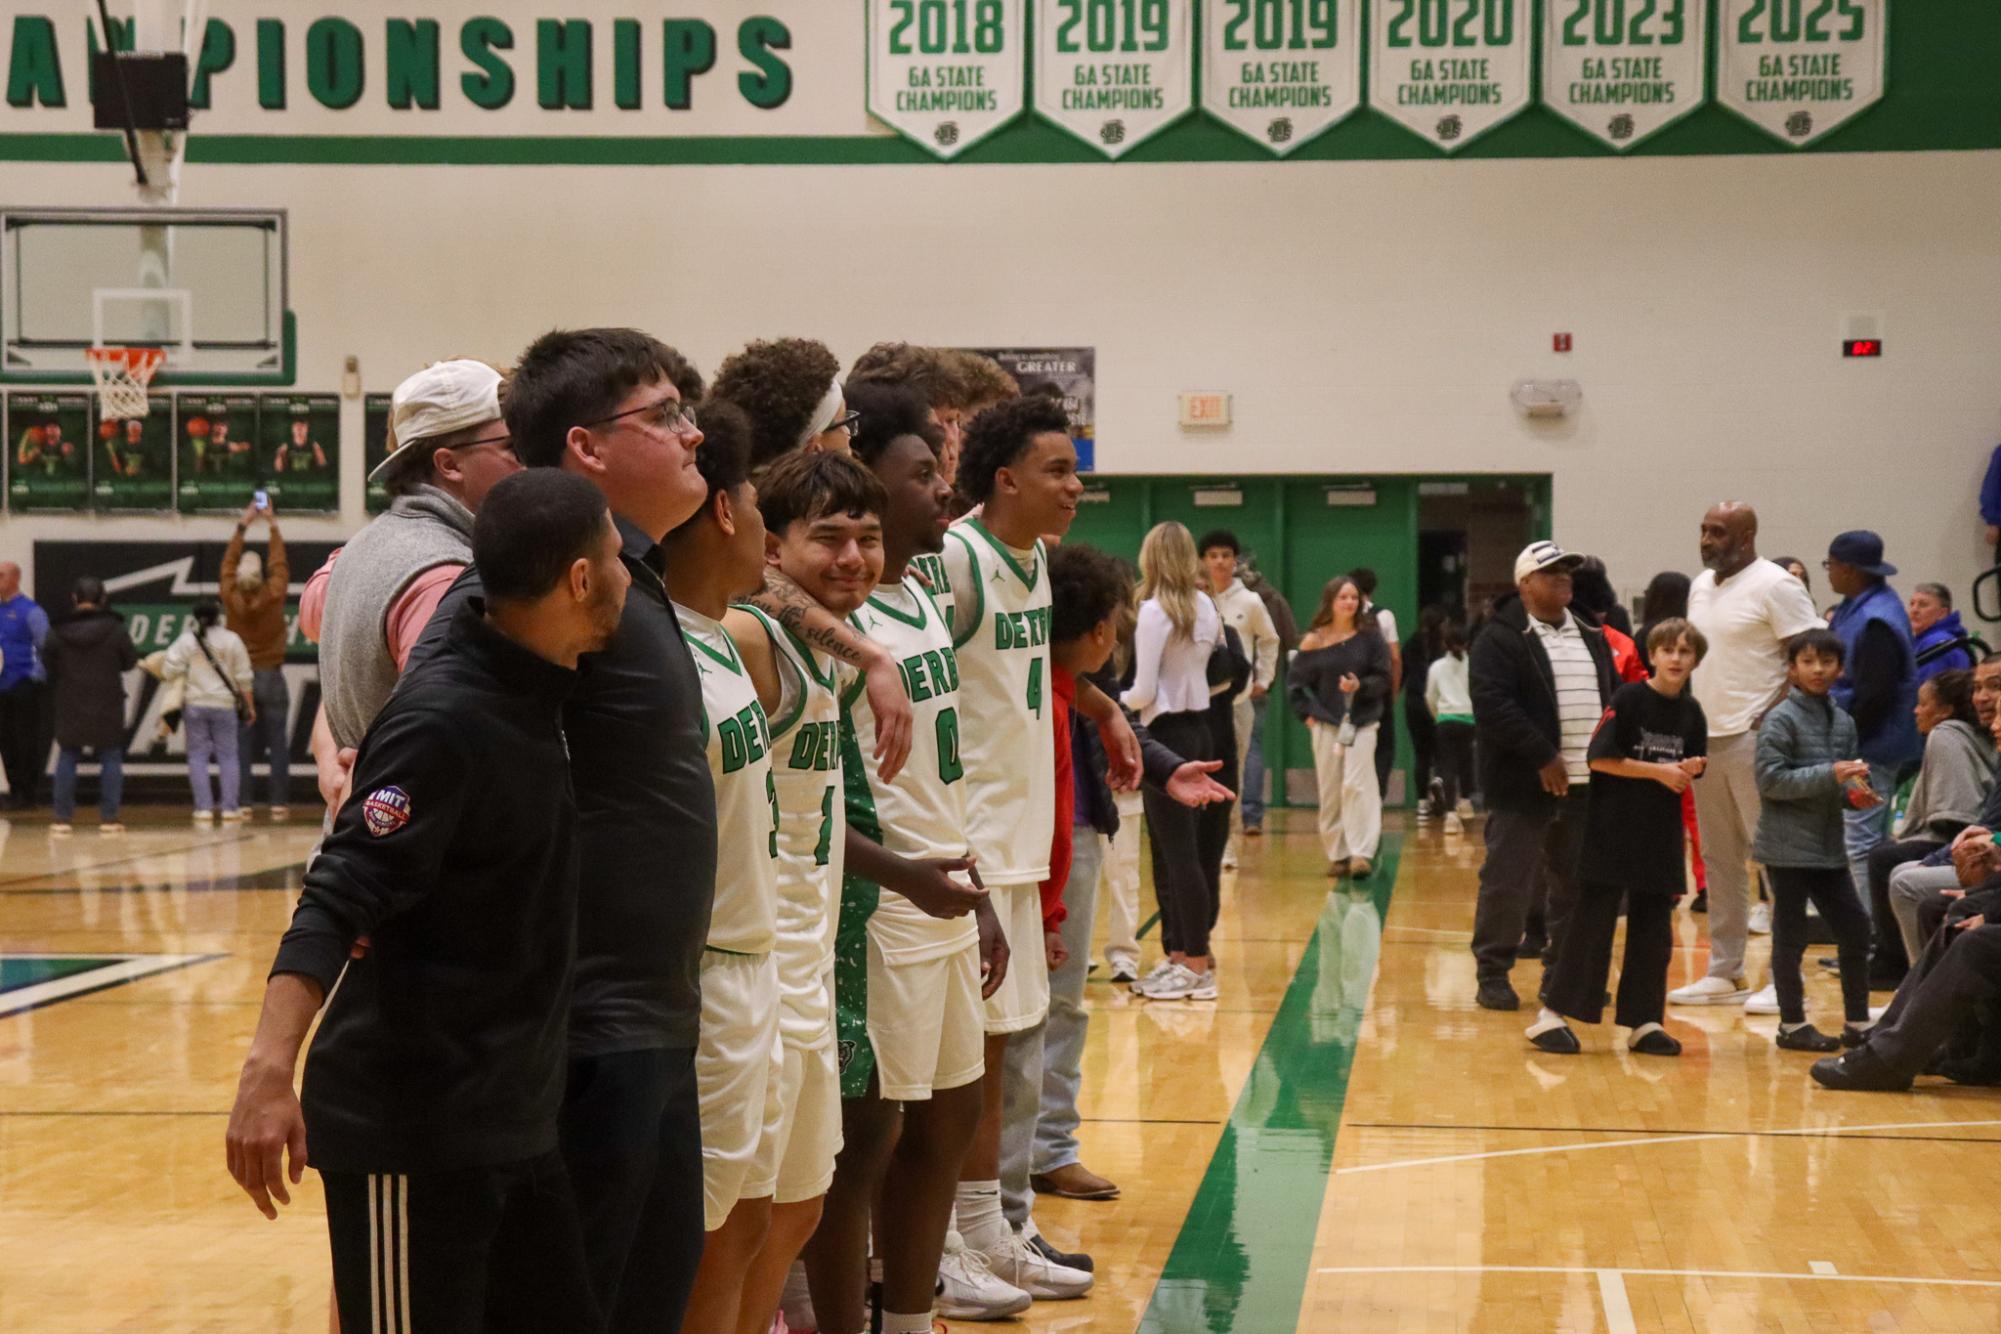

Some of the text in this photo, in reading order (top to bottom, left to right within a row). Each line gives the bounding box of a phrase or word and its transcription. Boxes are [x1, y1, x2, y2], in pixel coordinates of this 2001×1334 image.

[889, 0, 1004, 55] 2018
[1056, 0, 1170, 54] 2019
[1224, 0, 1338, 51] 2019
[1387, 0, 1514, 48] 2020
[1562, 0, 1685, 46] 2023
[1737, 0, 1865, 44] 2025
[936, 65, 985, 87] STATE
[1102, 64, 1151, 85] STATE
[1269, 61, 1319, 83] STATE
[1439, 58, 1489, 80] STATE
[1612, 57, 1662, 79] STATE
[1787, 53, 1841, 76] STATE
[896, 90, 998, 111] CHAMPIONS
[1062, 88, 1164, 110] CHAMPIONS
[1229, 86, 1332, 108] CHAMPIONS
[1397, 83, 1502, 105] CHAMPIONS
[1569, 82, 1675, 104] CHAMPIONS
[1745, 78, 1853, 102] CHAMPIONS
[1016, 361, 1077, 373] GREATER
[1189, 395, 1222, 420] EXIT
[807, 626, 862, 660] silence
[1026, 657, 1043, 721] 4
[935, 706, 964, 786] 0
[376, 789, 406, 808] MIT
[813, 785, 836, 866] 1
